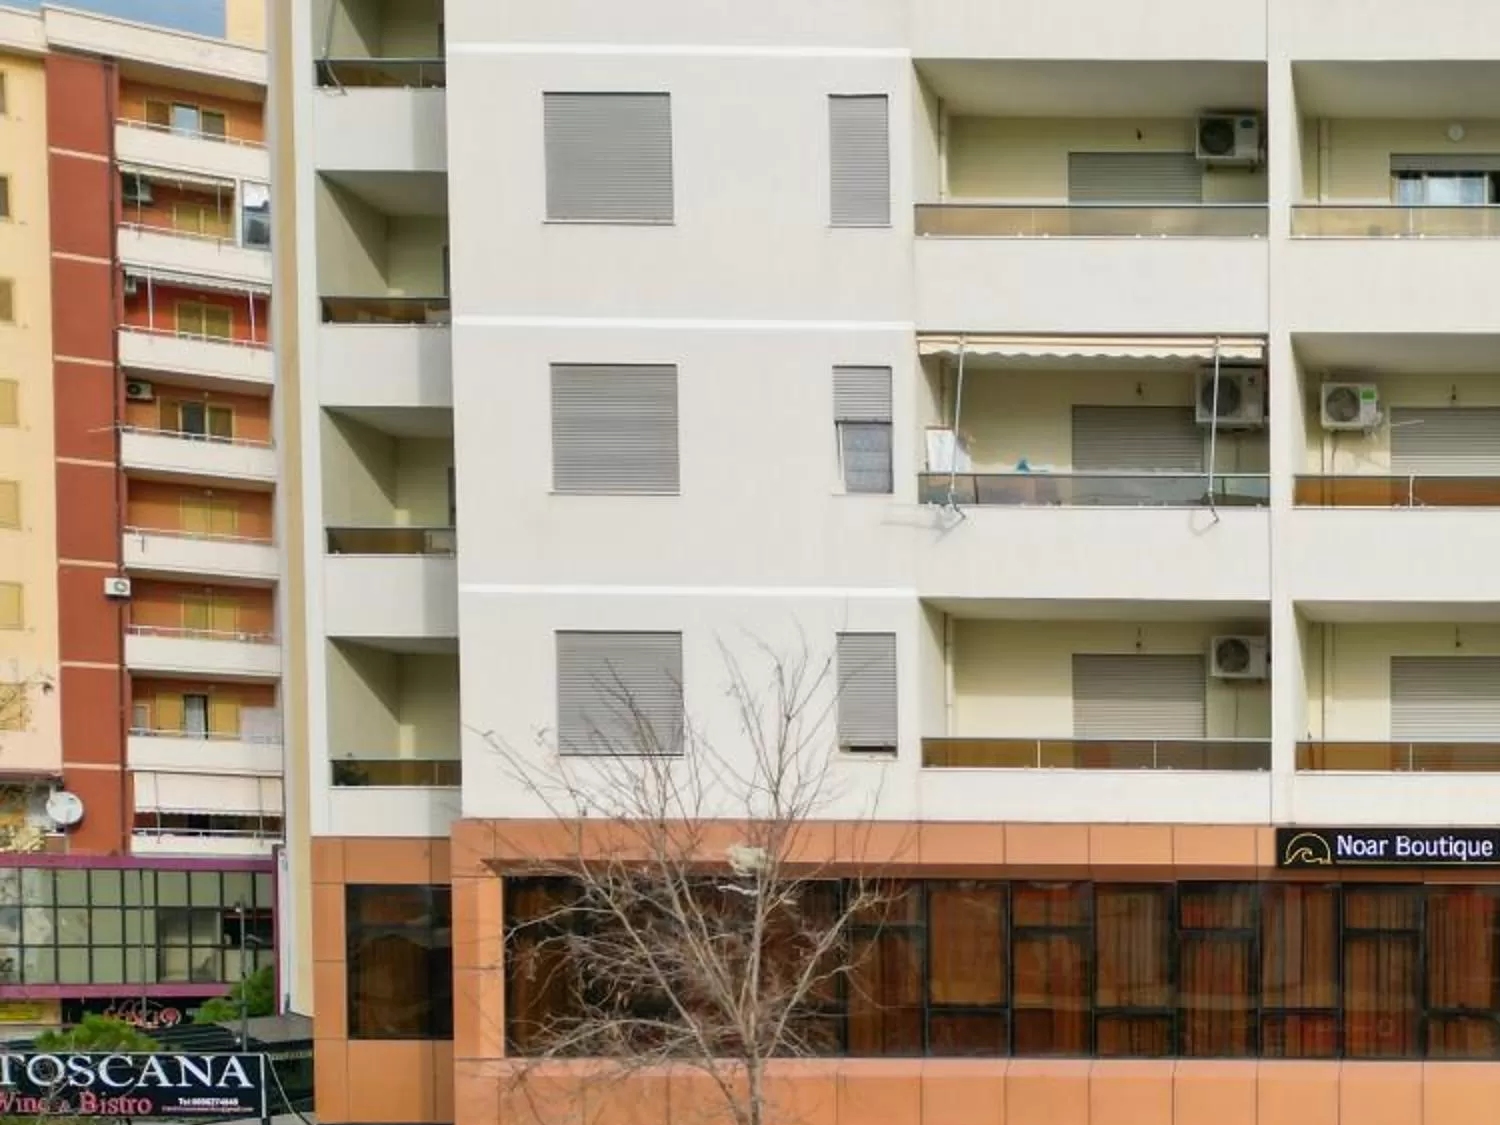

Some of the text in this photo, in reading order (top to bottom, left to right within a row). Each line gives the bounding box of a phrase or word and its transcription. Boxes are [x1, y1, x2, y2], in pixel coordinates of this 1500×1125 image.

[1336, 835, 1388, 857] Noar
[1396, 835, 1493, 861] Boutique
[0, 1055, 255, 1088] TOSCANA
[80, 1090, 152, 1115] Bistro
